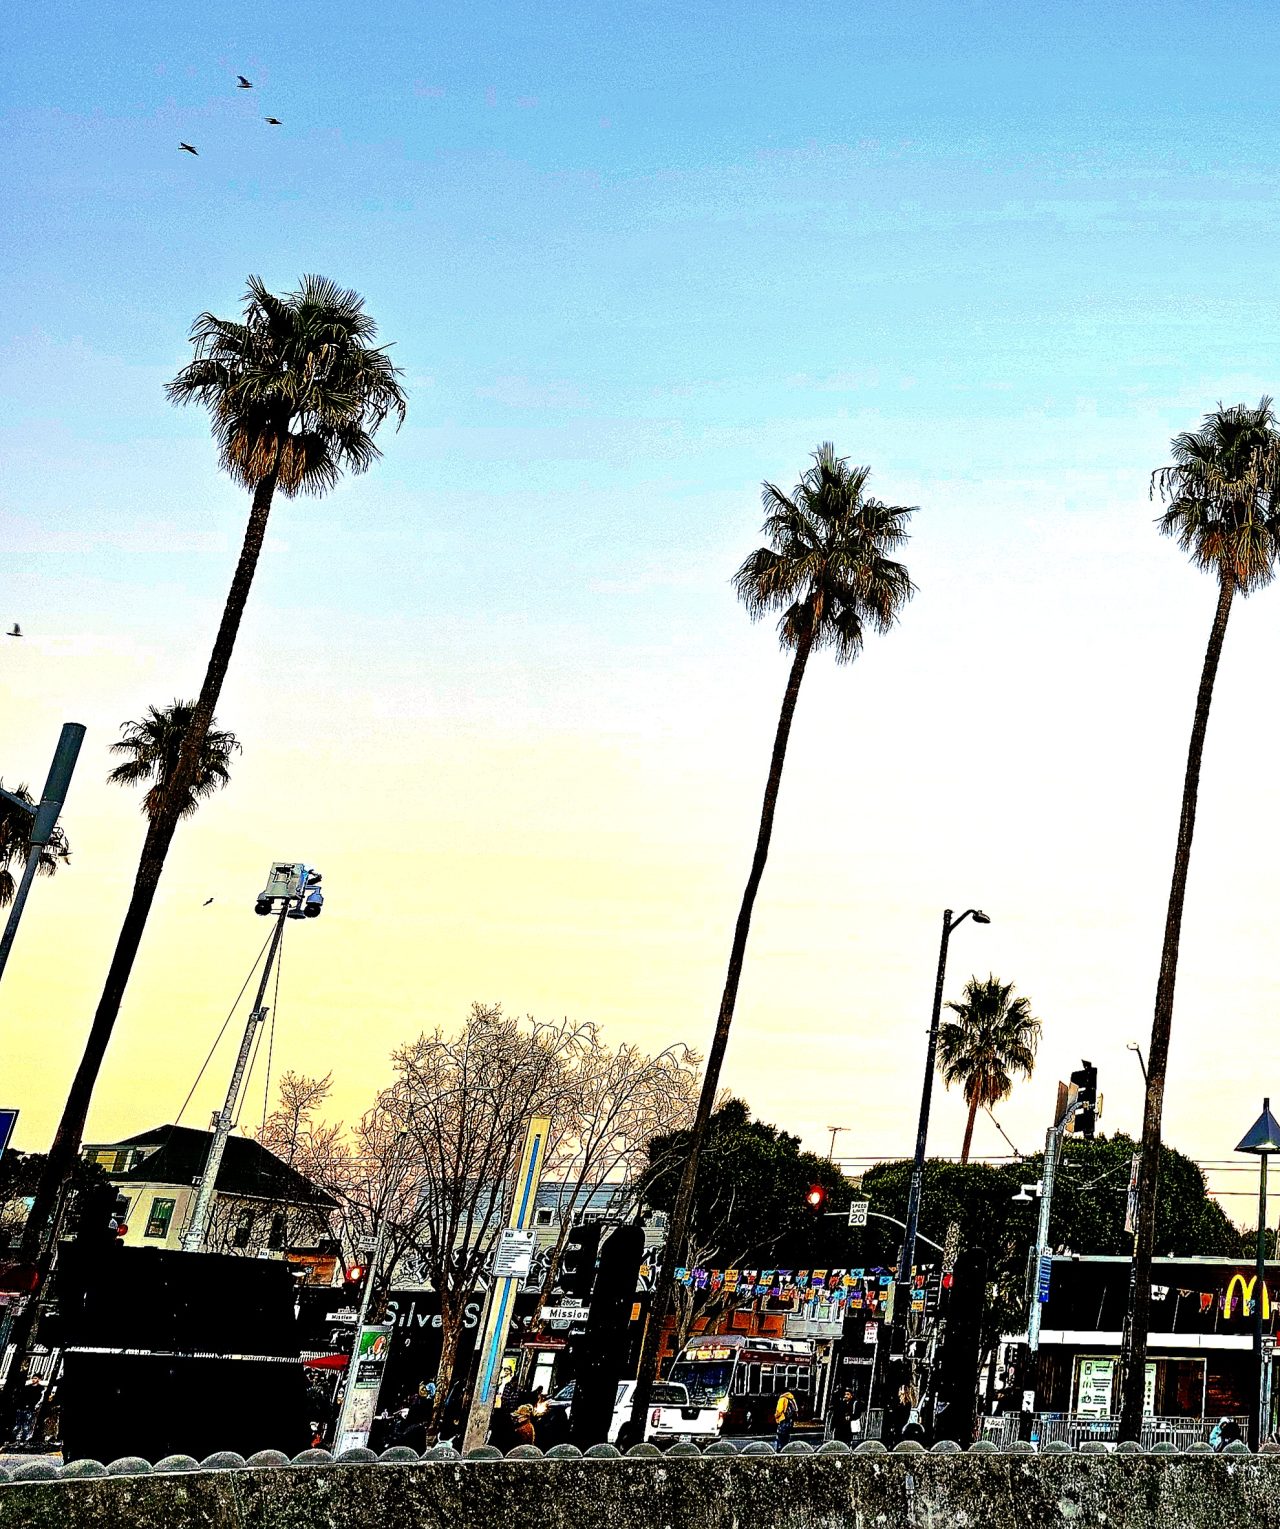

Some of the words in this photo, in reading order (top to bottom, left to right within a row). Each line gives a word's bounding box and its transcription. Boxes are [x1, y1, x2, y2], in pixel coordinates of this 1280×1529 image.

[850, 1213, 865, 1224] 20
[382, 1301, 443, 1328] Silve
[550, 1309, 589, 1319] Mission
